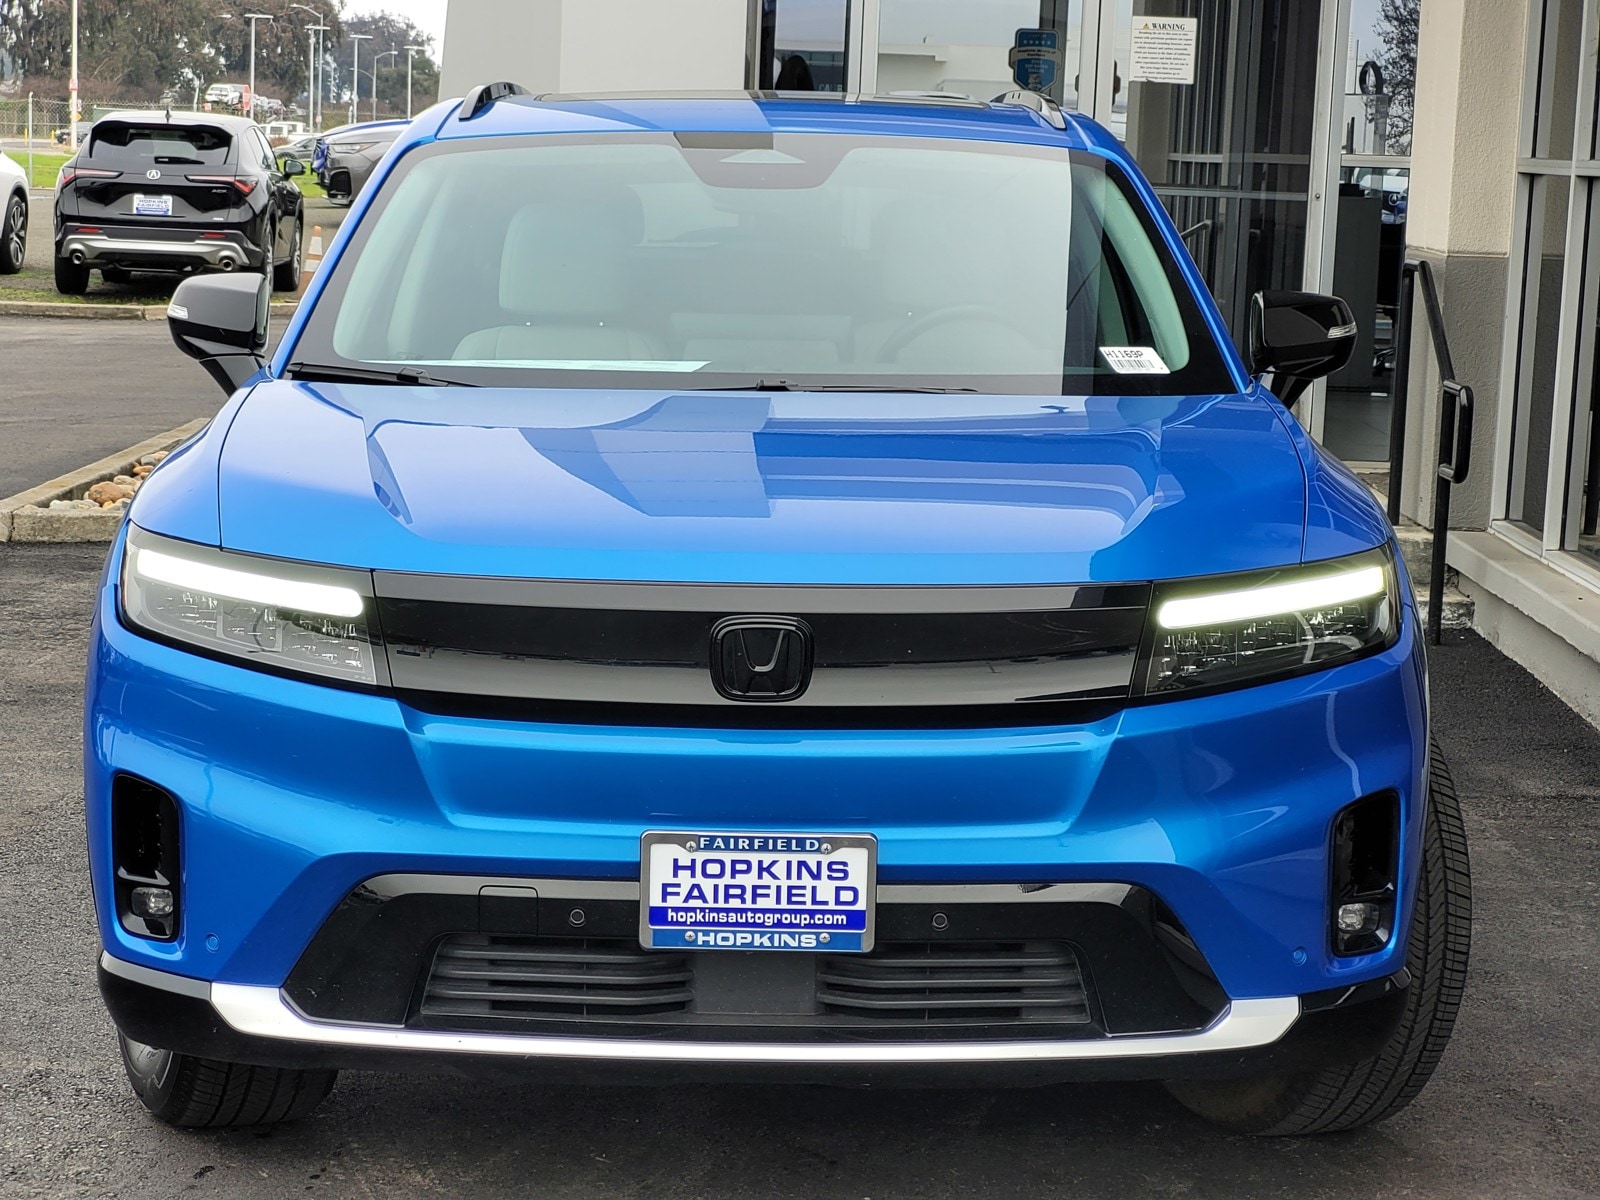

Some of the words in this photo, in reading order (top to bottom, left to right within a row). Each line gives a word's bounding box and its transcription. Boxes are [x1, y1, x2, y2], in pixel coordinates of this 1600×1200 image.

[1151, 22, 1186, 31] WARNING
[1103, 350, 1144, 359] H1169P
[699, 837, 820, 851] FAIRFIELD
[672, 857, 850, 882] HOPKINS
[660, 882, 860, 907] FAIRFIELD
[667, 908, 847, 927] hopkinsautogroup.com
[696, 932, 818, 948] HOPKINS
